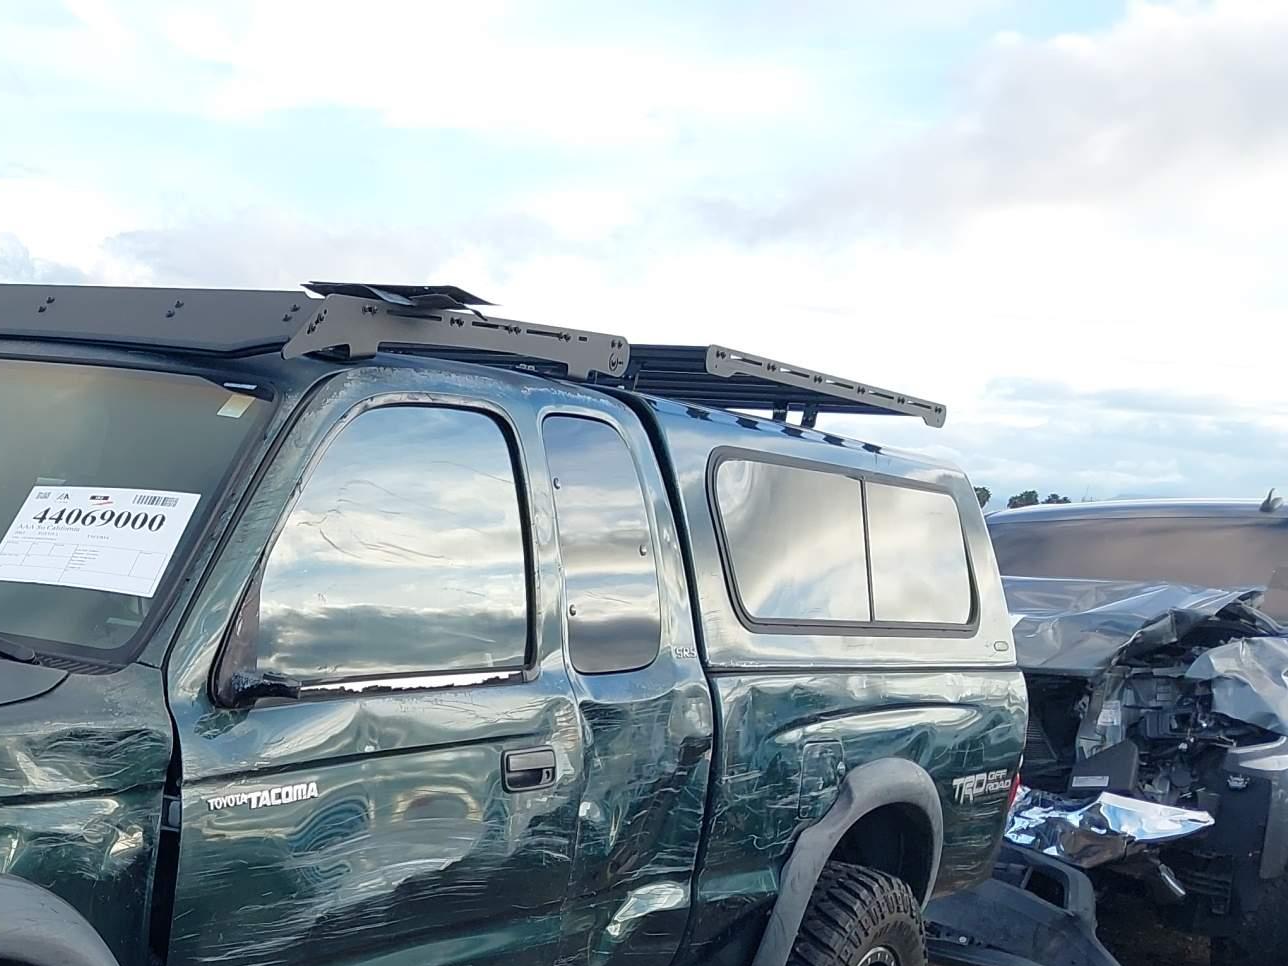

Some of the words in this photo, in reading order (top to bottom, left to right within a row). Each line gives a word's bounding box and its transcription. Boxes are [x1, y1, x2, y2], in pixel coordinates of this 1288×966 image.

[33, 508, 166, 532] 44069000
[986, 779, 1012, 793] ROAD
[987, 769, 1008, 781] OFF
[207, 793, 248, 811] TOYOTA
[247, 782, 319, 809] TACOMA
[952, 772, 987, 805] TRD
